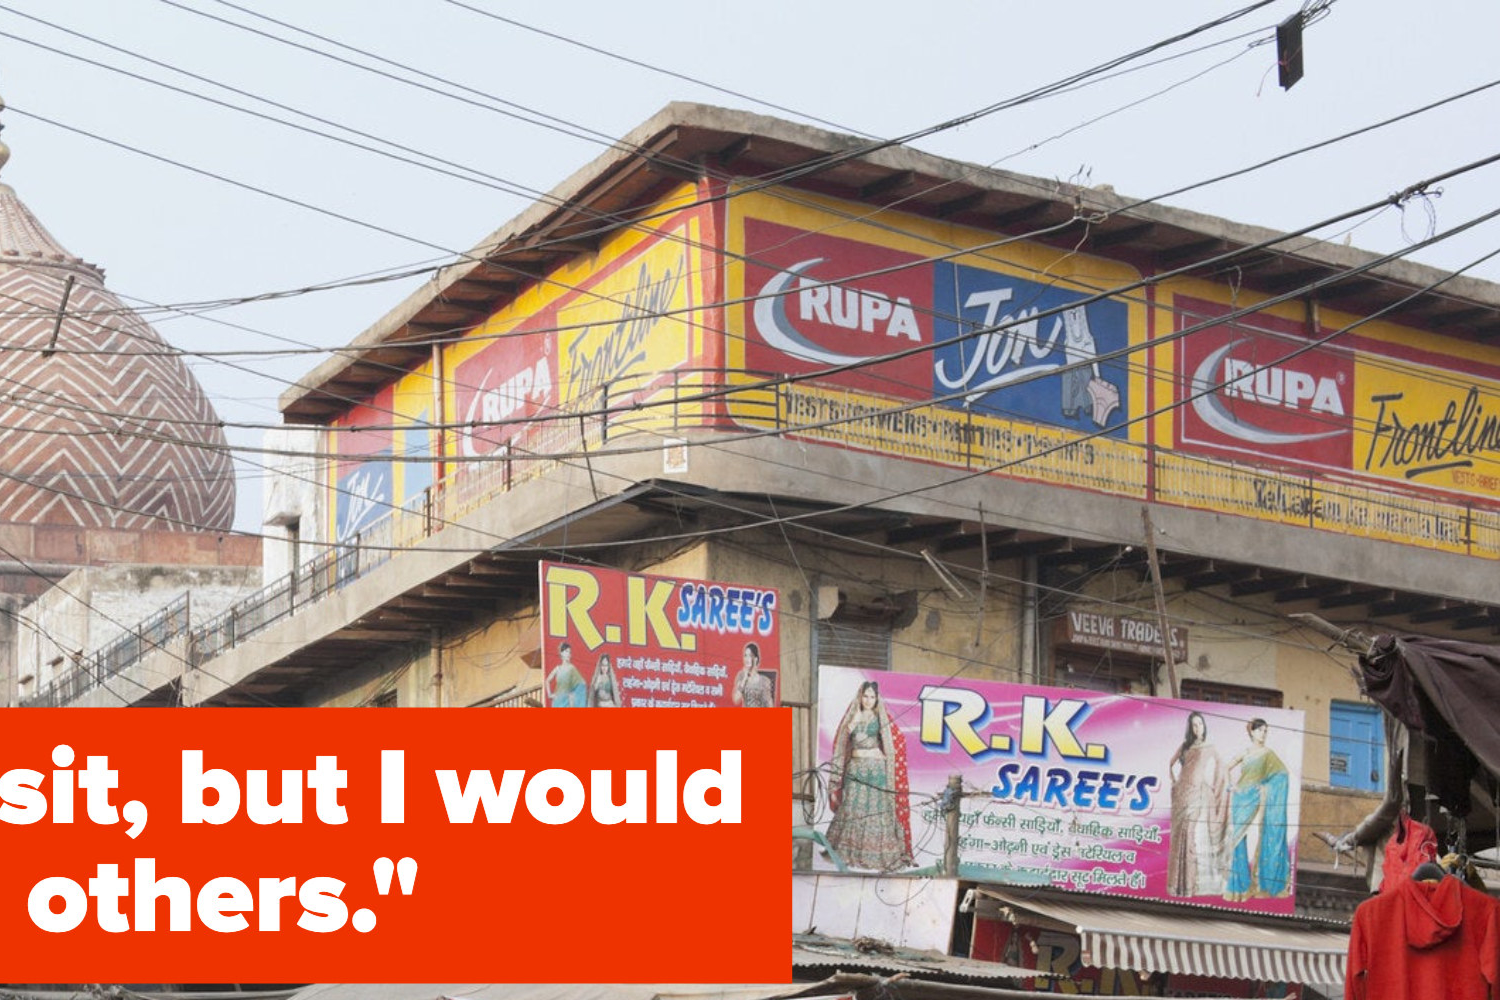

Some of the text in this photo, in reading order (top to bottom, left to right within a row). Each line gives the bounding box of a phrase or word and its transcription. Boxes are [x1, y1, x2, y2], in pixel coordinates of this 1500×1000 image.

[799, 277, 921, 341] RUPA
[936, 286, 1061, 388] Jon
[482, 357, 552, 418] RUPA
[1224, 357, 1344, 416] RUPA
[1365, 386, 1500, 470] Frontlin
[545, 564, 697, 651] R.K.
[678, 583, 775, 634] SAREE'S
[918, 684, 1109, 762] R.K.
[991, 763, 1158, 812] SAREE'S
